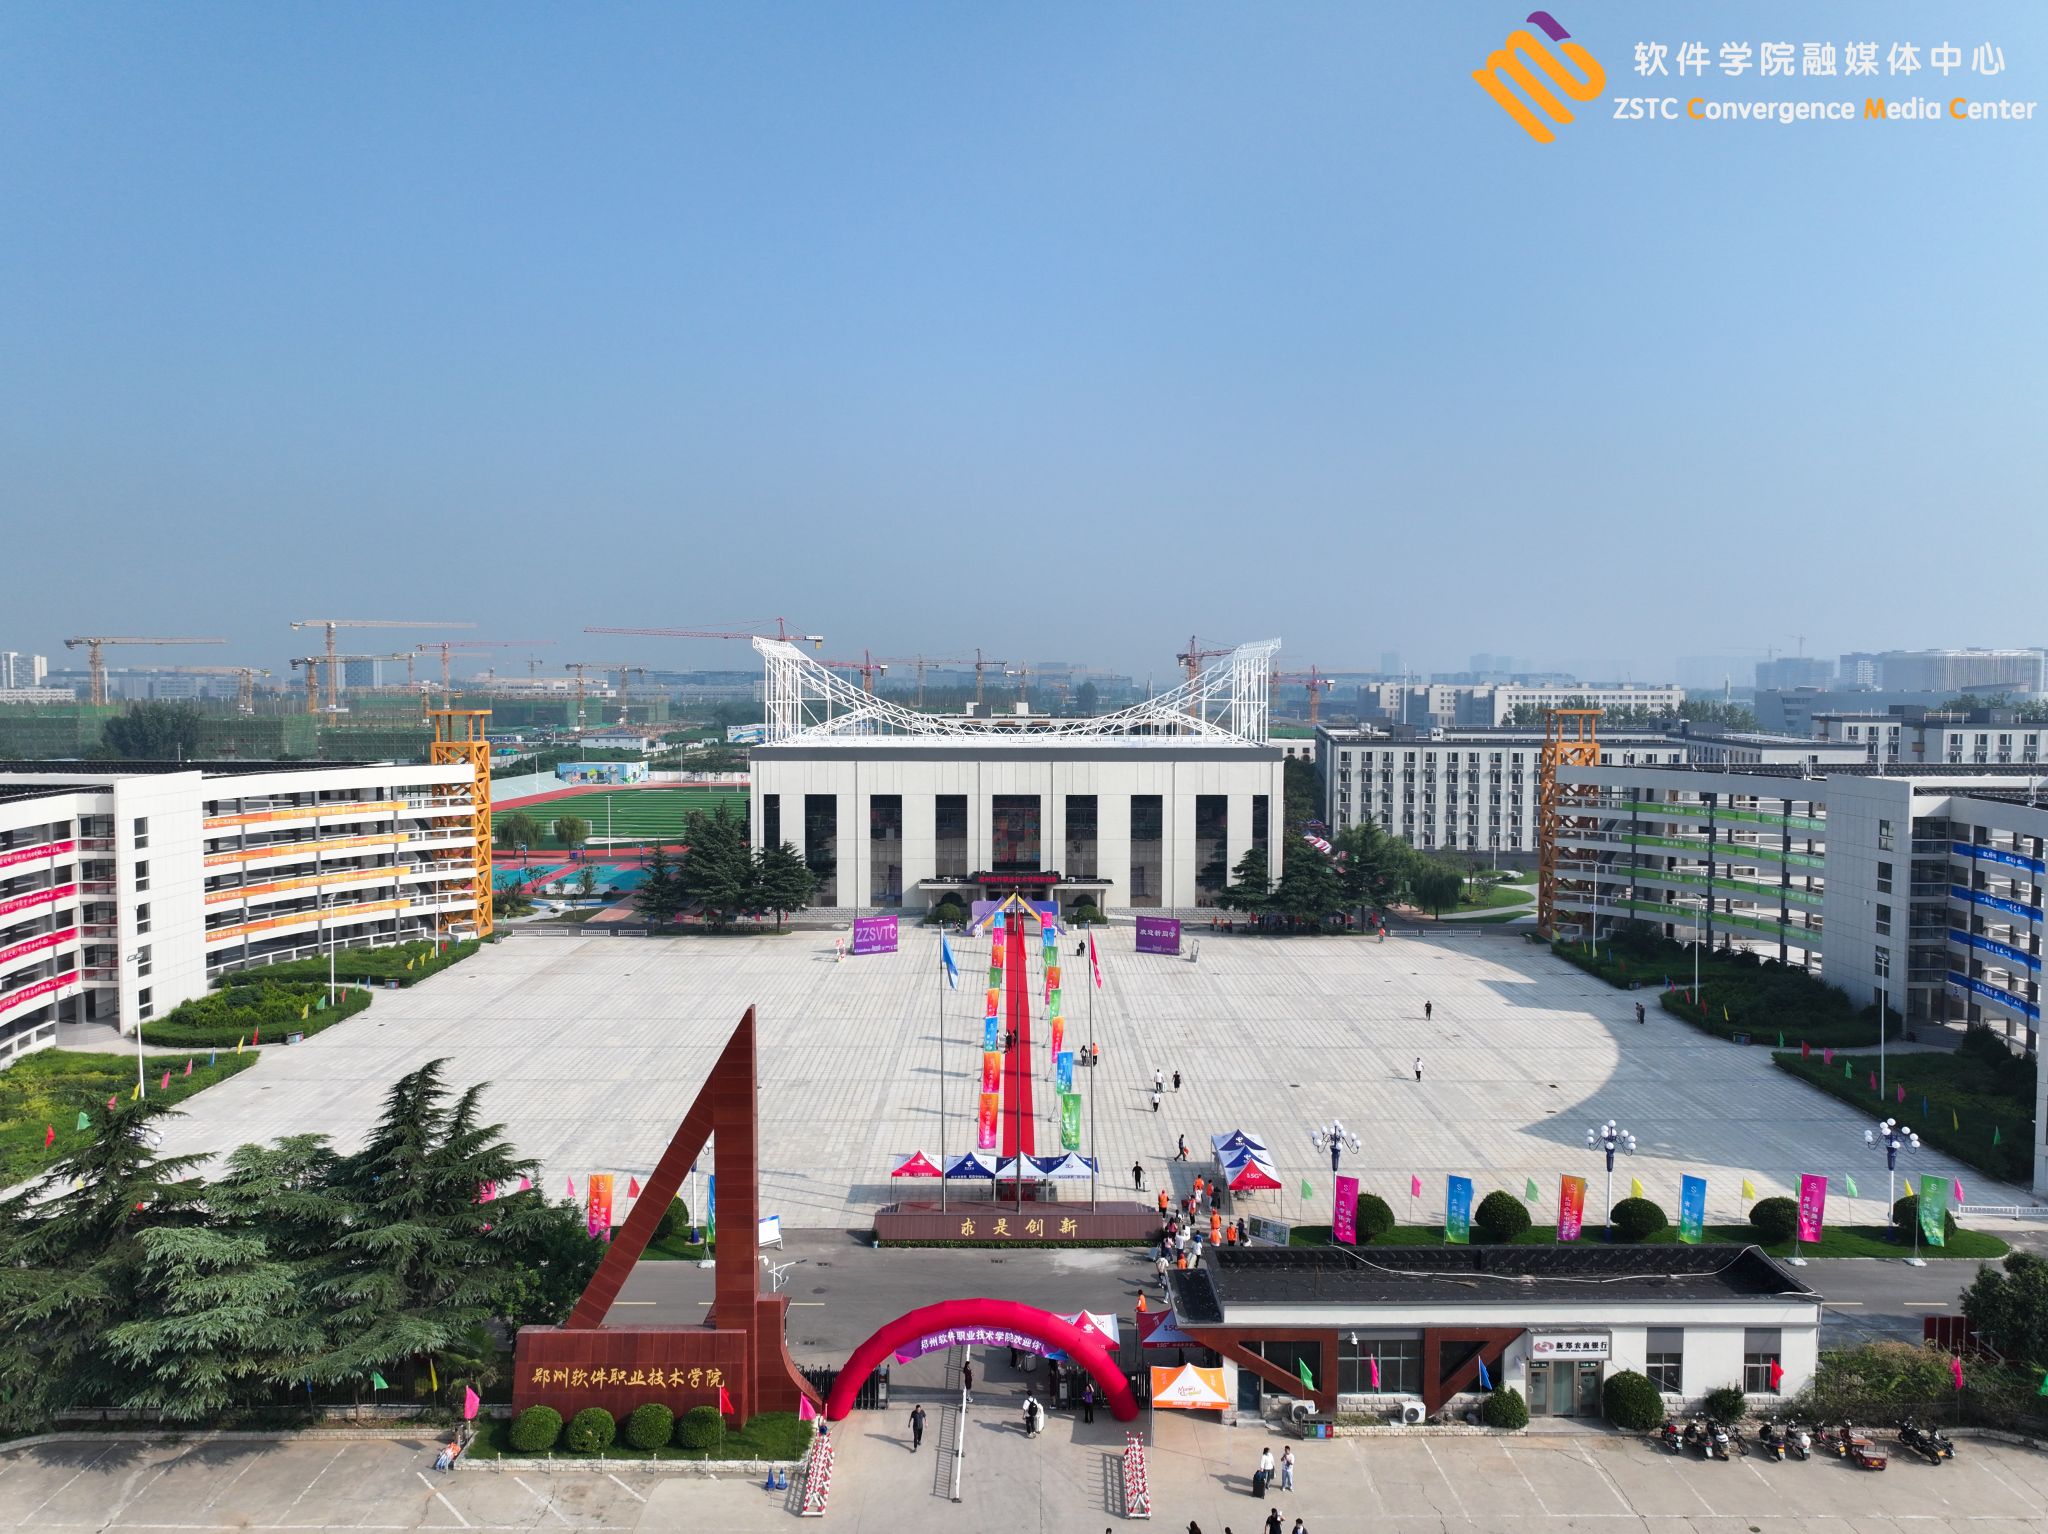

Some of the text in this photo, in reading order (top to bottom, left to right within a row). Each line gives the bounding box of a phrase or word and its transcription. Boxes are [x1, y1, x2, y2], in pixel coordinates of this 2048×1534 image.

[855, 925, 897, 942] ZZSVTC
[1140, 928, 1176, 938] 欢迎新同学
[960, 1217, 1078, 1238] 求是创新
[1556, 1341, 1607, 1349] 新郑农商银行
[531, 1367, 725, 1390] 郑州软件职业技术学院
